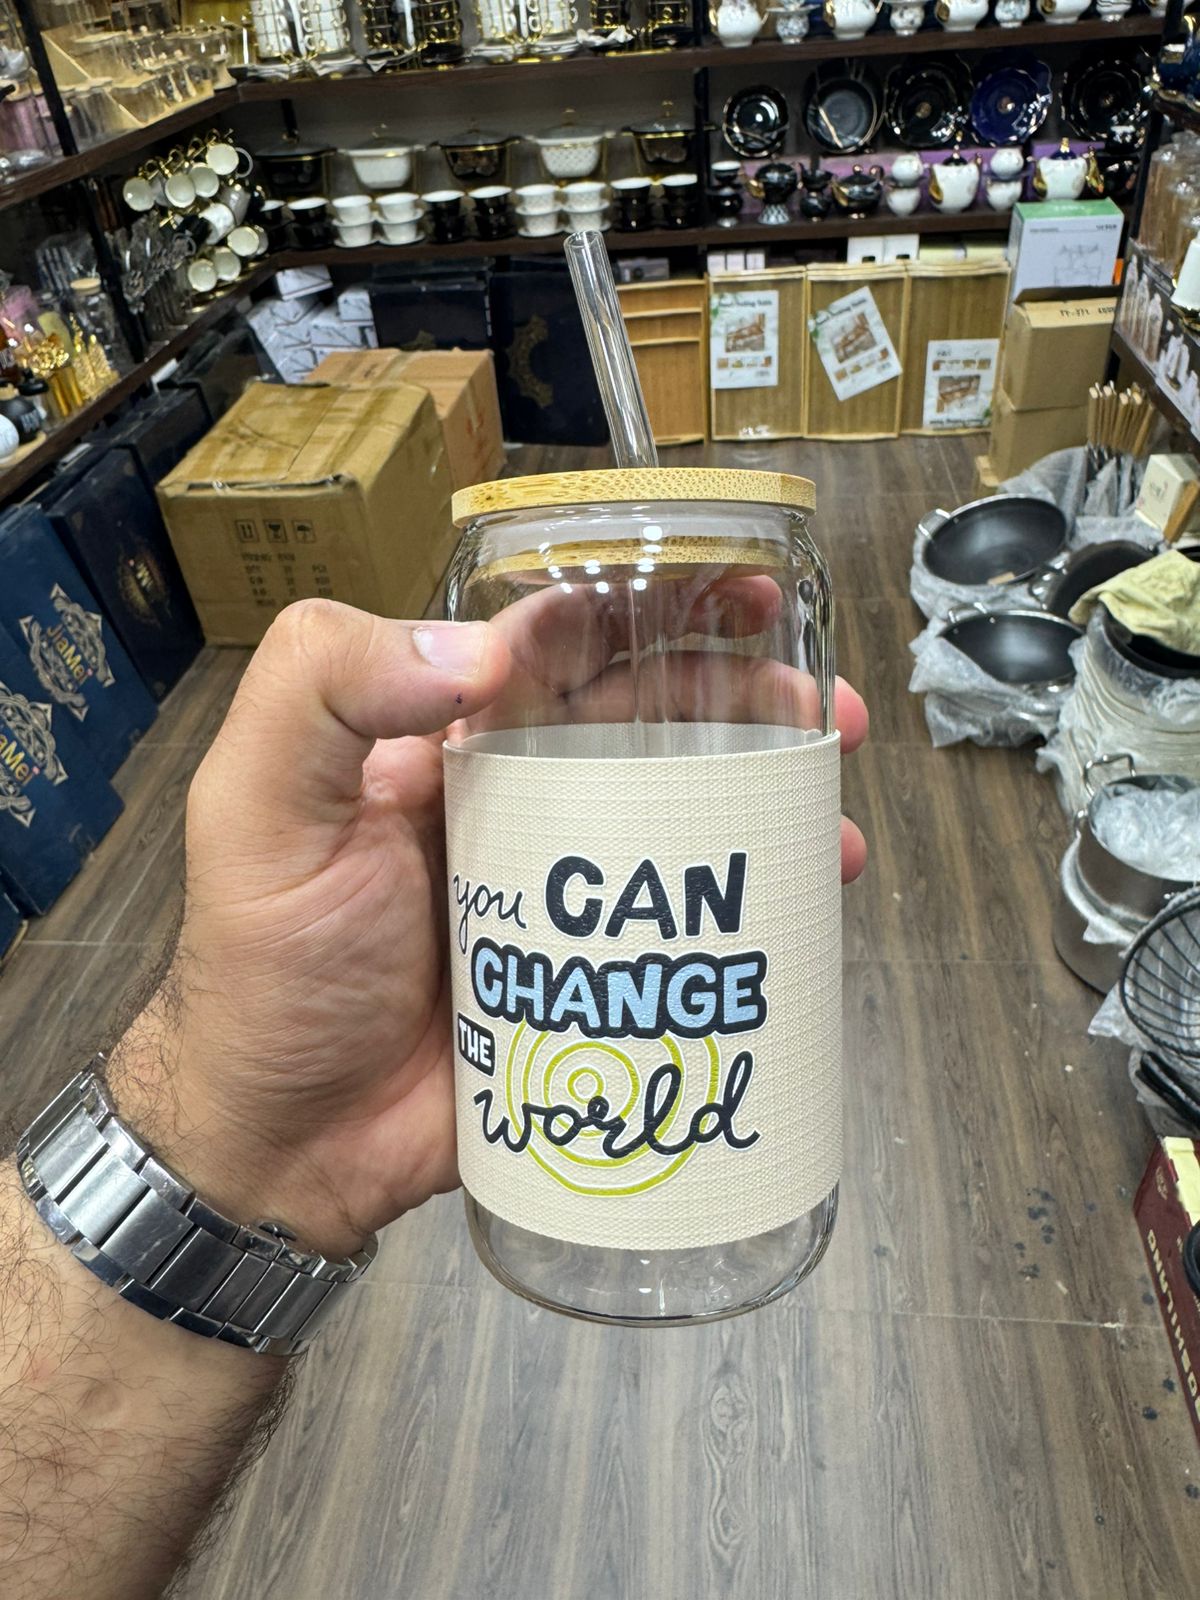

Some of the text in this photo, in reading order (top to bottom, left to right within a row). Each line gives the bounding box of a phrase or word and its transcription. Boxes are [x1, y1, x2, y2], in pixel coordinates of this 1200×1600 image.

[453, 852, 748, 955] you CAN
[473, 945, 762, 1033] CHANGE
[458, 1020, 493, 1068] THE
[473, 1051, 760, 1158] world
